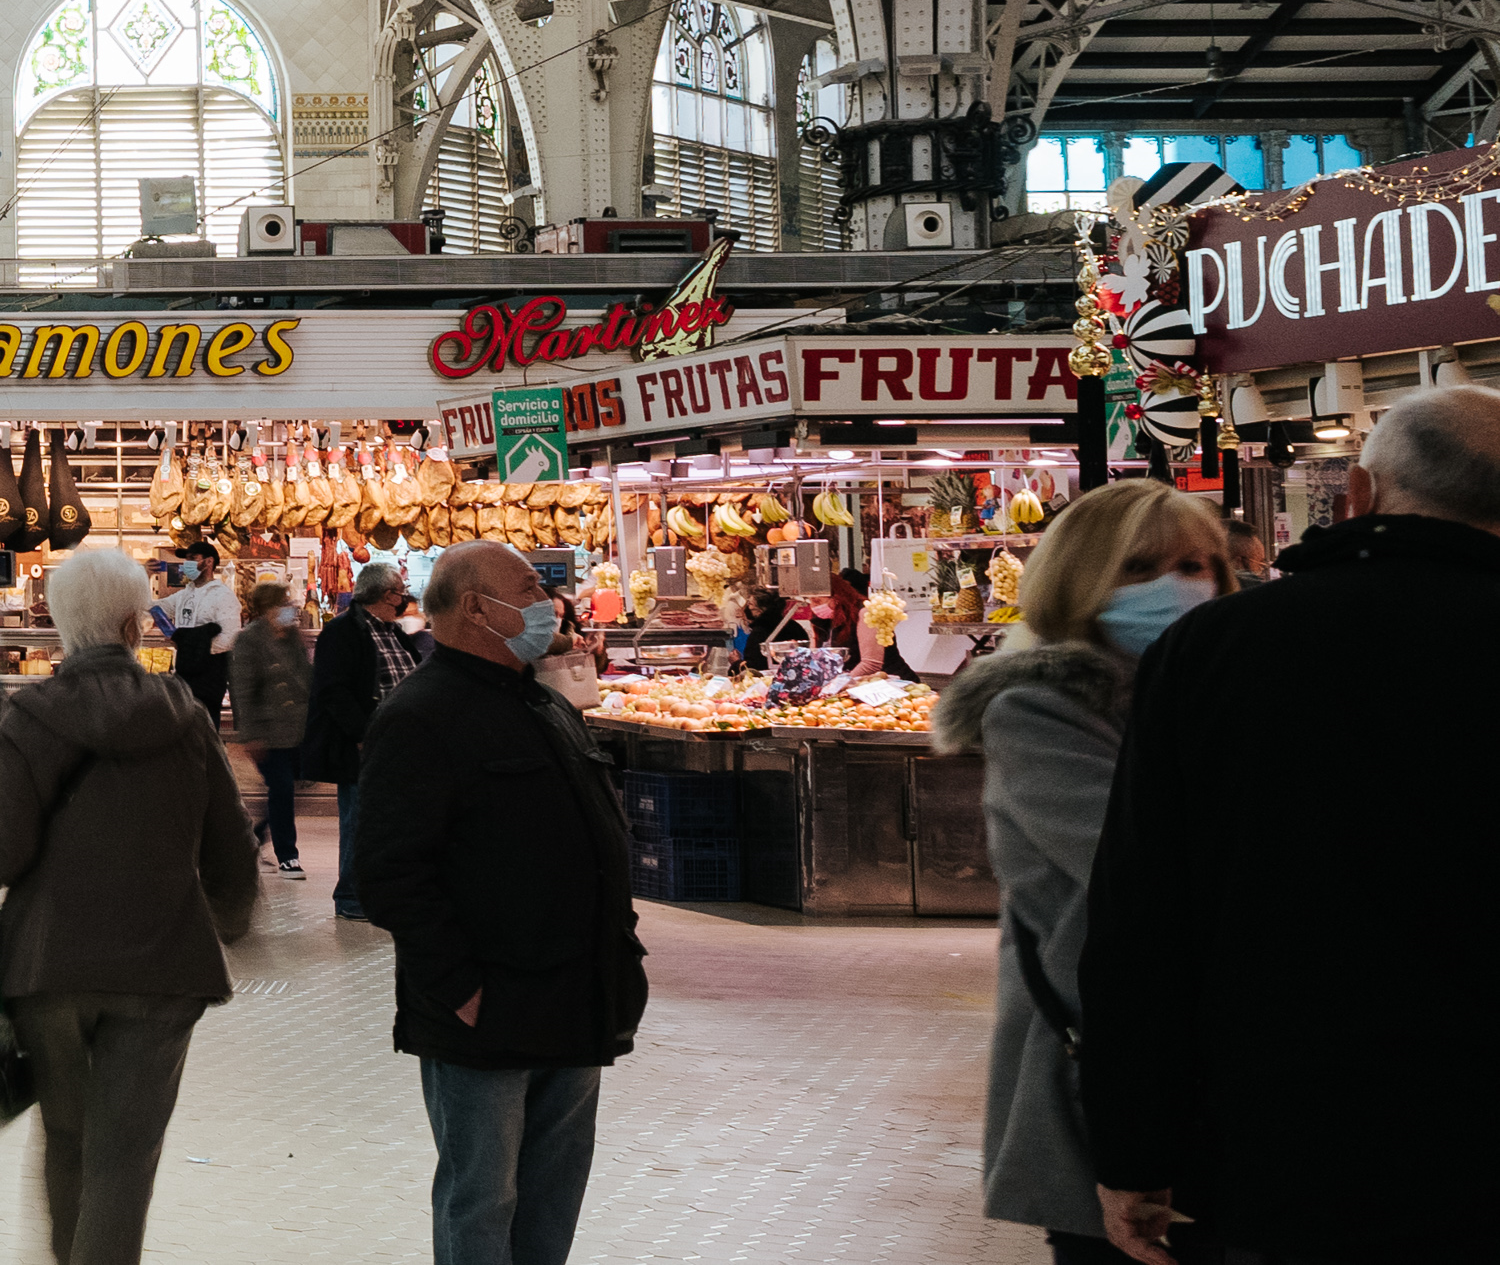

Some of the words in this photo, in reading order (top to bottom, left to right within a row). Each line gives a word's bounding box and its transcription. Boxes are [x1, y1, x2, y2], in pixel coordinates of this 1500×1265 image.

[430, 294, 734, 378] Martinez
[497, 398, 549, 412] Servicio
[551, 400, 560, 409] a
[636, 349, 790, 422] FRUTAS
[500, 411, 560, 426] domicilio
